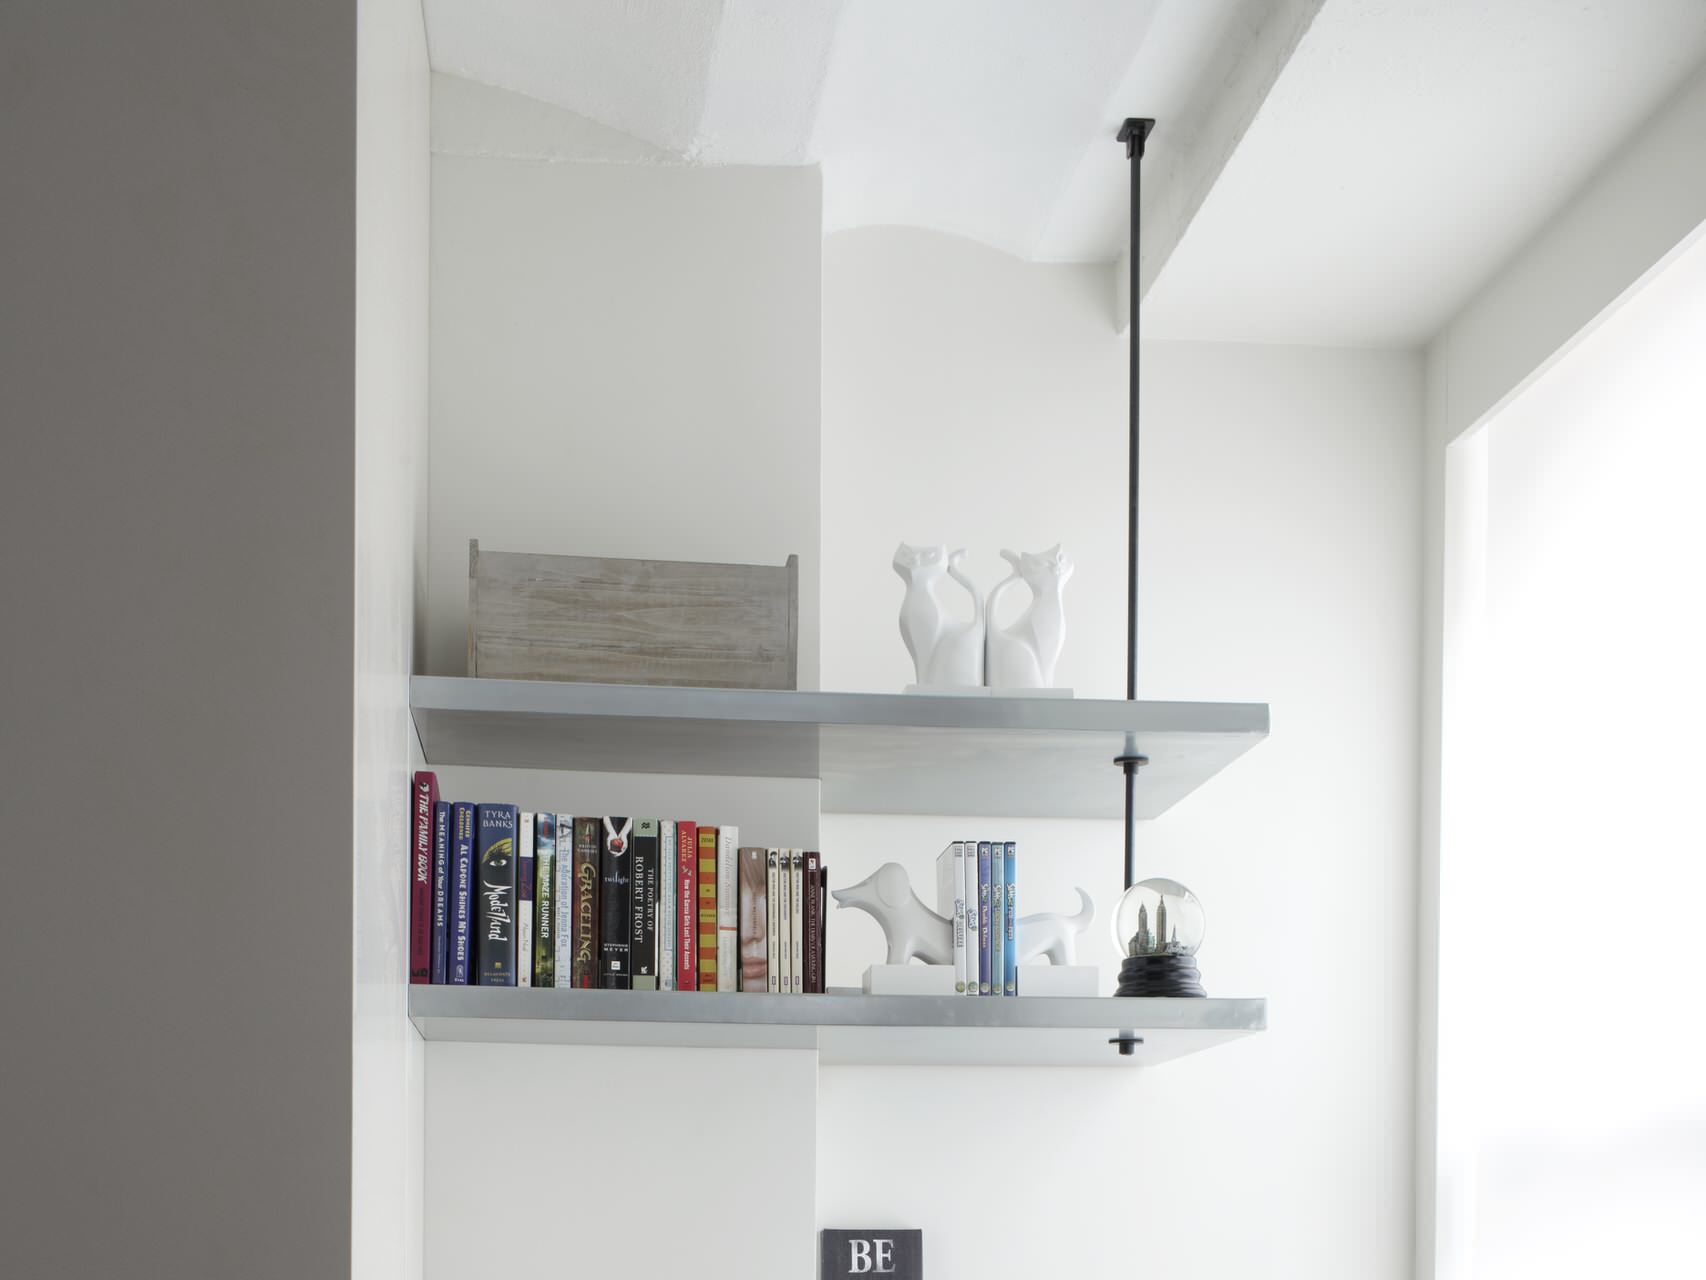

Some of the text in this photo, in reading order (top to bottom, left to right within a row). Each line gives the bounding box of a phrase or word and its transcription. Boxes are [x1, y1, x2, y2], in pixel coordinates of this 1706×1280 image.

[419, 794, 429, 815] THE
[485, 810, 511, 820] TYRA
[418, 815, 429, 854] FAMILY
[482, 820, 513, 829] BANKS
[417, 854, 428, 884] BOOK
[604, 872, 629, 885] twilight
[436, 891, 444, 927] DREAMS
[577, 863, 596, 963] GRACELING
[634, 856, 644, 943] ROBERT FROST
[541, 901, 549, 938] RUNNER
[647, 920, 653, 931] OF
[848, 1239, 896, 1273] BE
